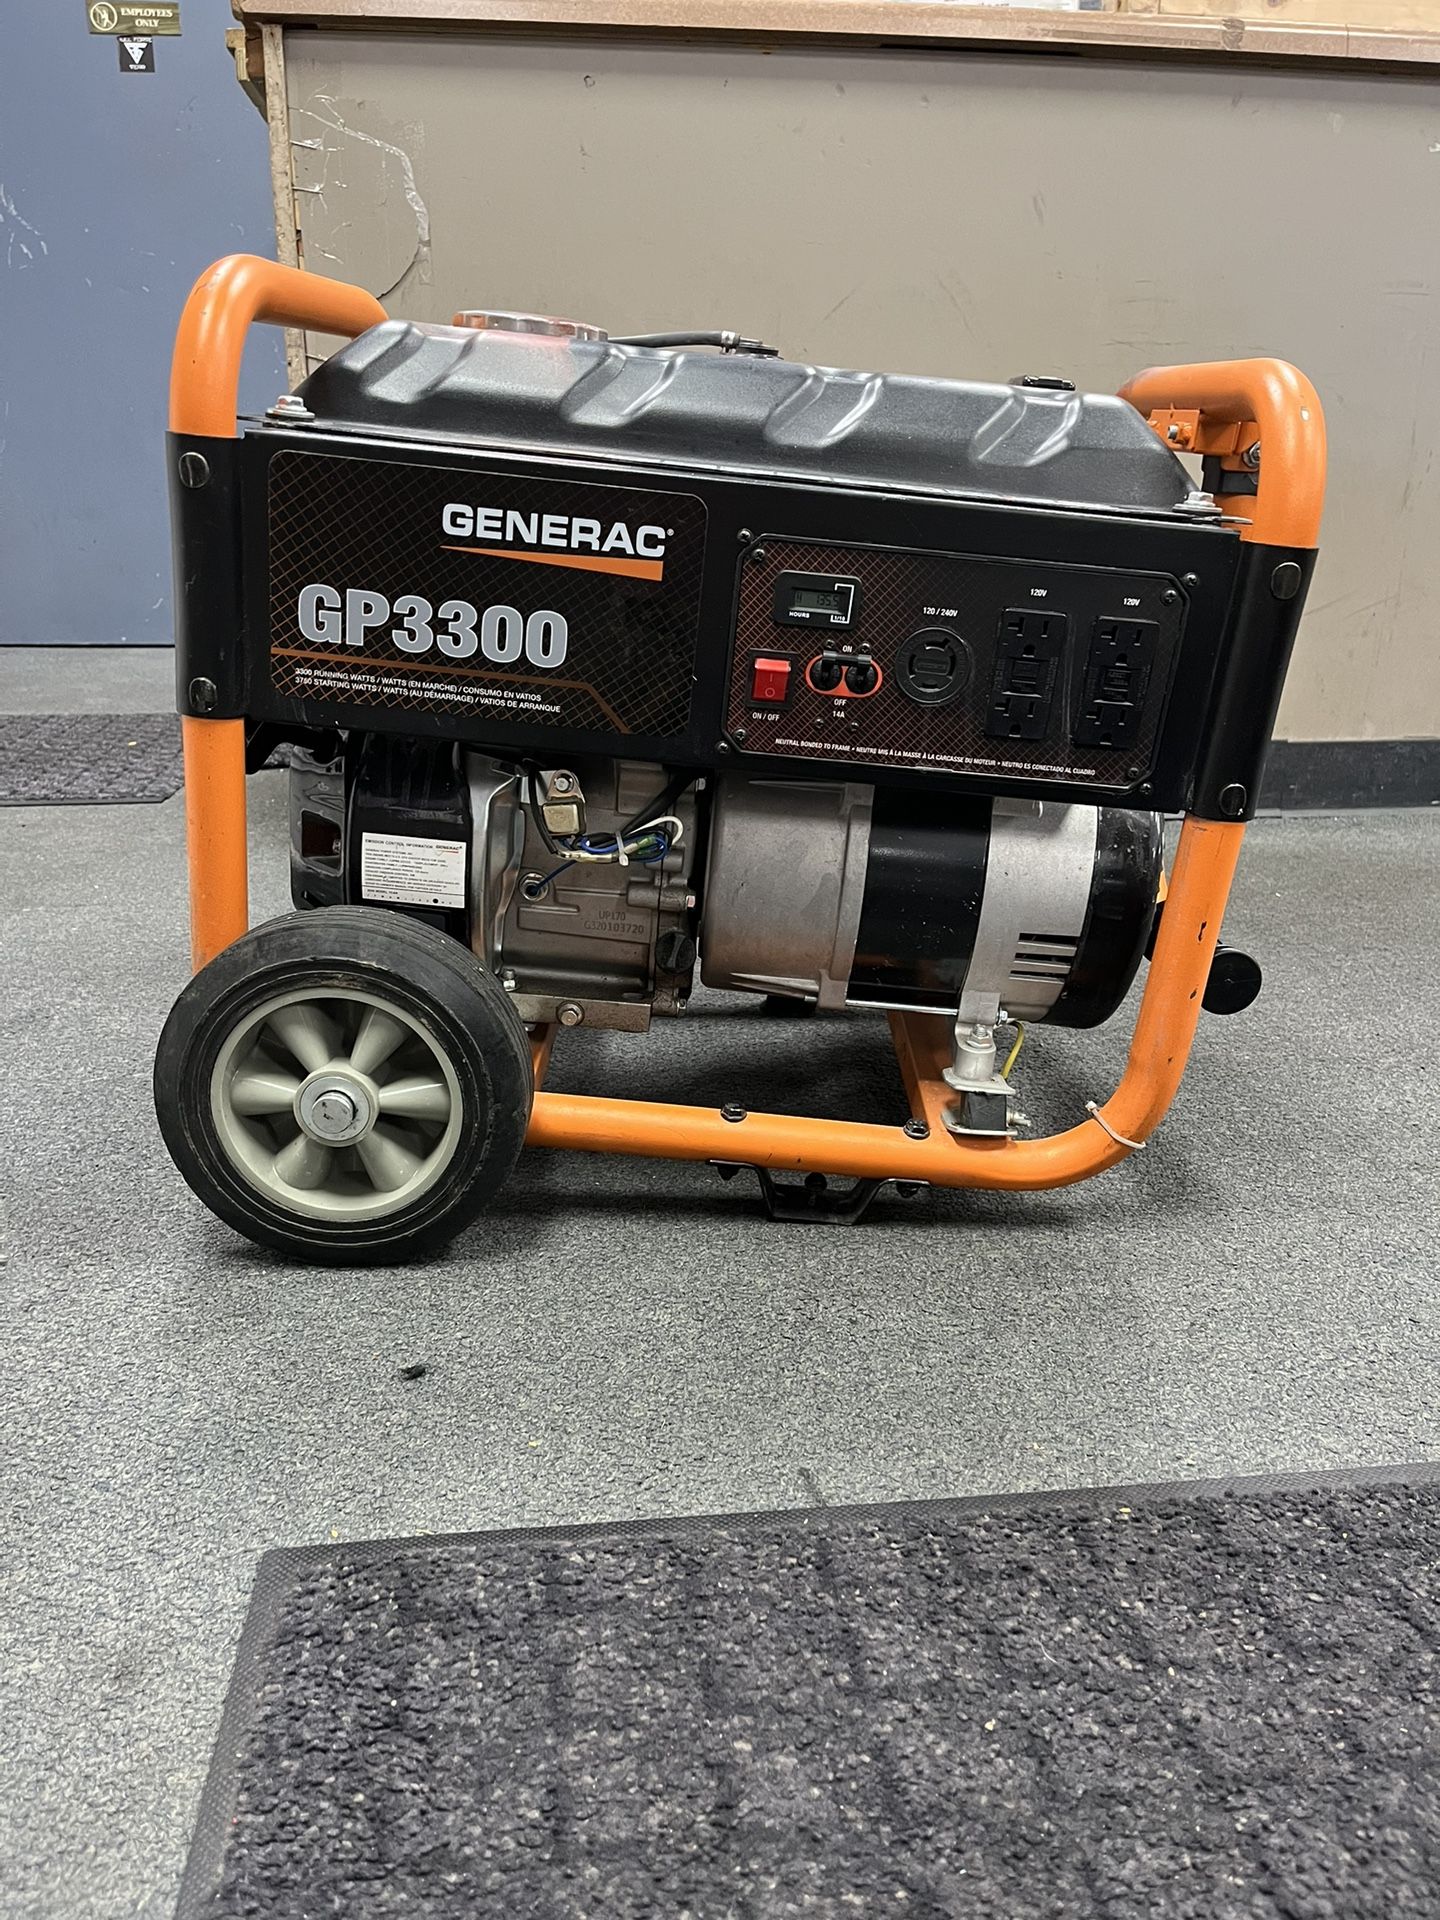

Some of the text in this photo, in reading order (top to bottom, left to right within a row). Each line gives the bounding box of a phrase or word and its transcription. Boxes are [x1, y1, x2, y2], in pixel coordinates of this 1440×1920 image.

[120, 7, 173, 18] EMPLOYEES
[135, 18, 160, 27] ONLY
[441, 502, 667, 558] GENERAC
[1030, 588, 1048, 597] 120V
[1123, 597, 1140, 607] 120V
[922, 606, 935, 615] 120
[940, 608, 958, 617] 240V
[297, 583, 569, 669] GP3300
[842, 645, 853, 653] ON
[294, 667, 313, 676] 3300
[313, 669, 349, 680] RUNNING
[350, 673, 376, 683] WATTS
[381, 676, 407, 687] WATTS
[408, 680, 421, 689] (EN
[422, 682, 457, 693] MARCHE)
[463, 686, 502, 698] CONSUMO
[503, 690, 514, 699] EN
[515, 692, 542, 702] VATIOS
[313, 678, 350, 689] STARTING
[351, 682, 377, 692] WATTS
[383, 686, 409, 696] WATTS
[409, 689, 423, 698] (AU
[424, 690, 474, 704] DÉMARRAGE)
[480, 697, 506, 707] VATIOS
[507, 699, 518, 708] DE
[519, 701, 561, 713] ARRANQUE
[752, 711, 762, 719] ON
[767, 713, 780, 721] OFF
[832, 710, 845, 718] 14A
[775, 738, 799, 747] NEUTRAL
[800, 740, 823, 749] BONDED
[823, 742, 831, 750] TO
[832, 743, 851, 752] FRAME
[856, 746, 877, 755] NEUTRE
[878, 748, 889, 756] MIS
[902, 750, 921, 759] MASSE
[935, 754, 964, 763] CARCASSE
[973, 758, 996, 766] MOTEUR
[1001, 761, 1023, 769] NEUTRO
[1024, 762, 1031, 770] ES
[1032, 763, 1064, 773] CONECTADO
[1064, 766, 1072, 774] AL
[1072, 767, 1096, 776] CUADRO
[599, 910, 626, 921] UP170
